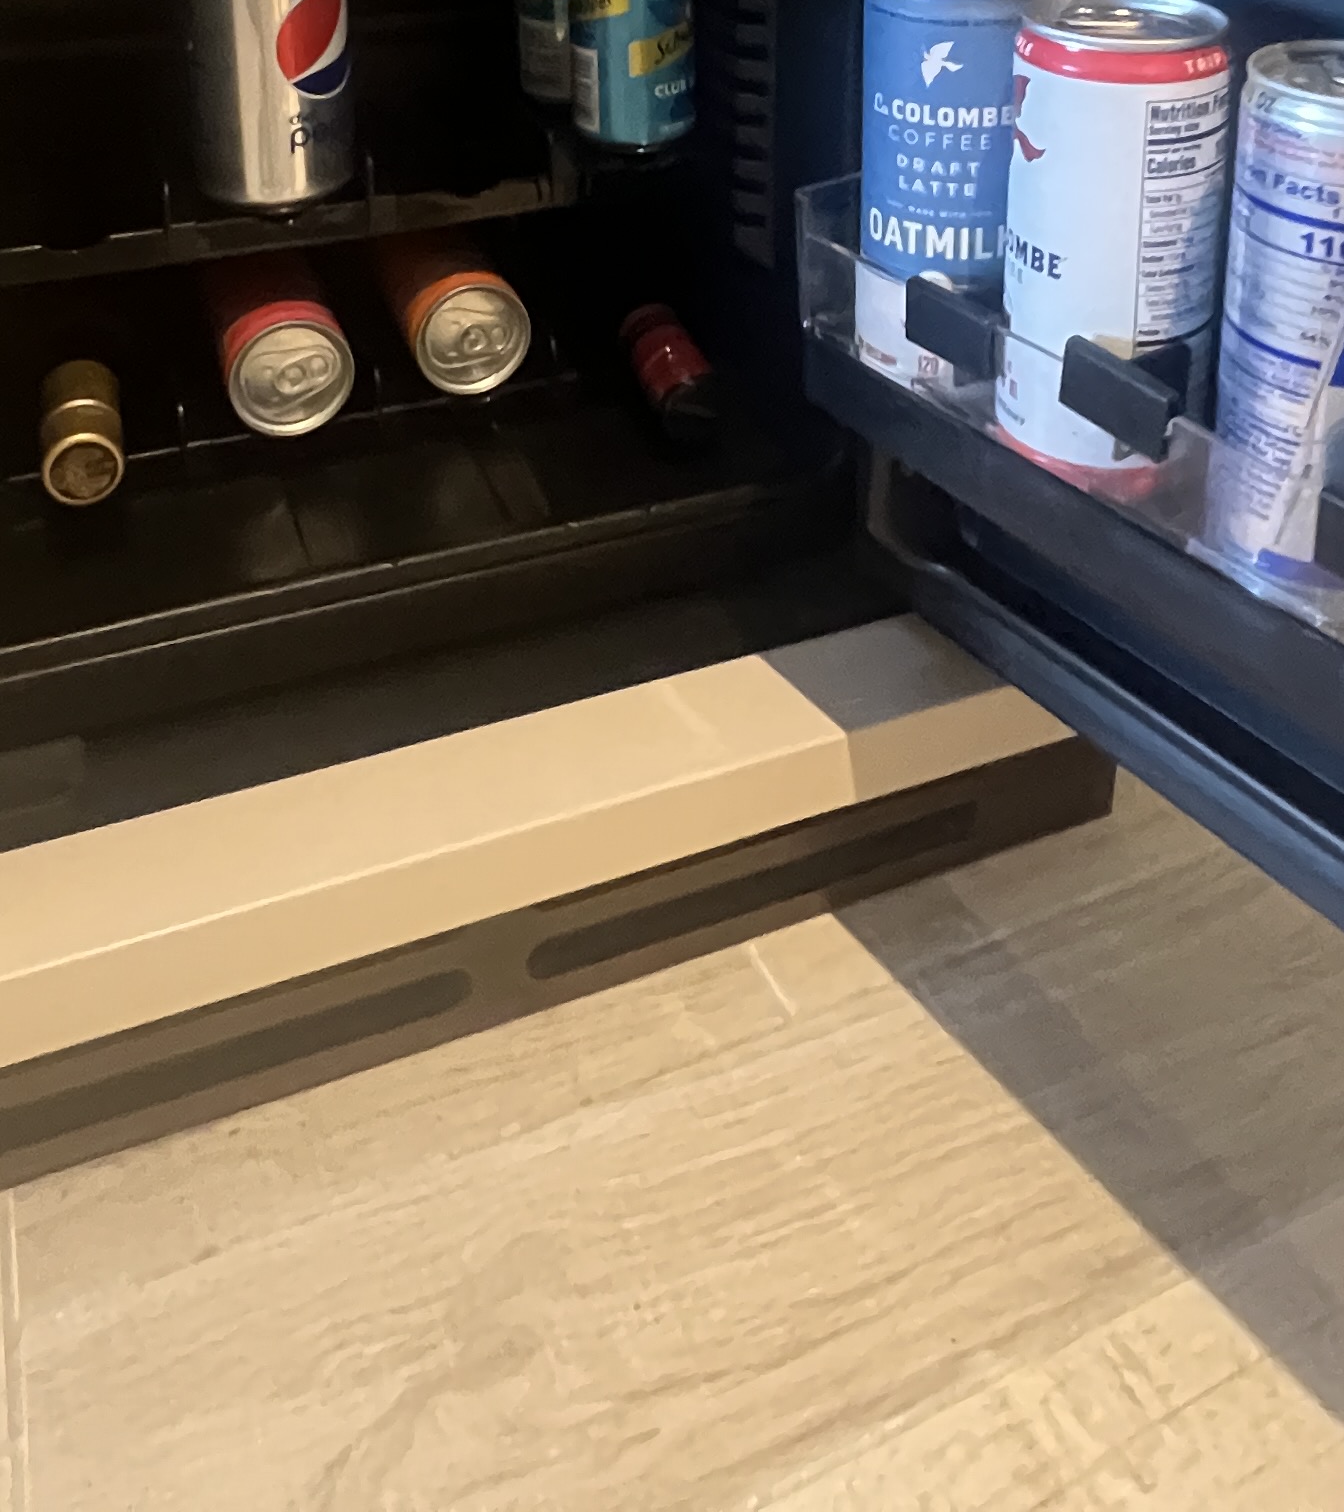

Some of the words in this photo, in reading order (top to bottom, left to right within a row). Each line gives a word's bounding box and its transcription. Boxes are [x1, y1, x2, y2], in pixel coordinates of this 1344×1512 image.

[891, 98, 1015, 129] COLOMBE
[888, 124, 992, 151] COFFEE
[896, 152, 981, 179] DRAFT
[1147, 155, 1197, 174] Calories
[898, 175, 977, 198] LATTE
